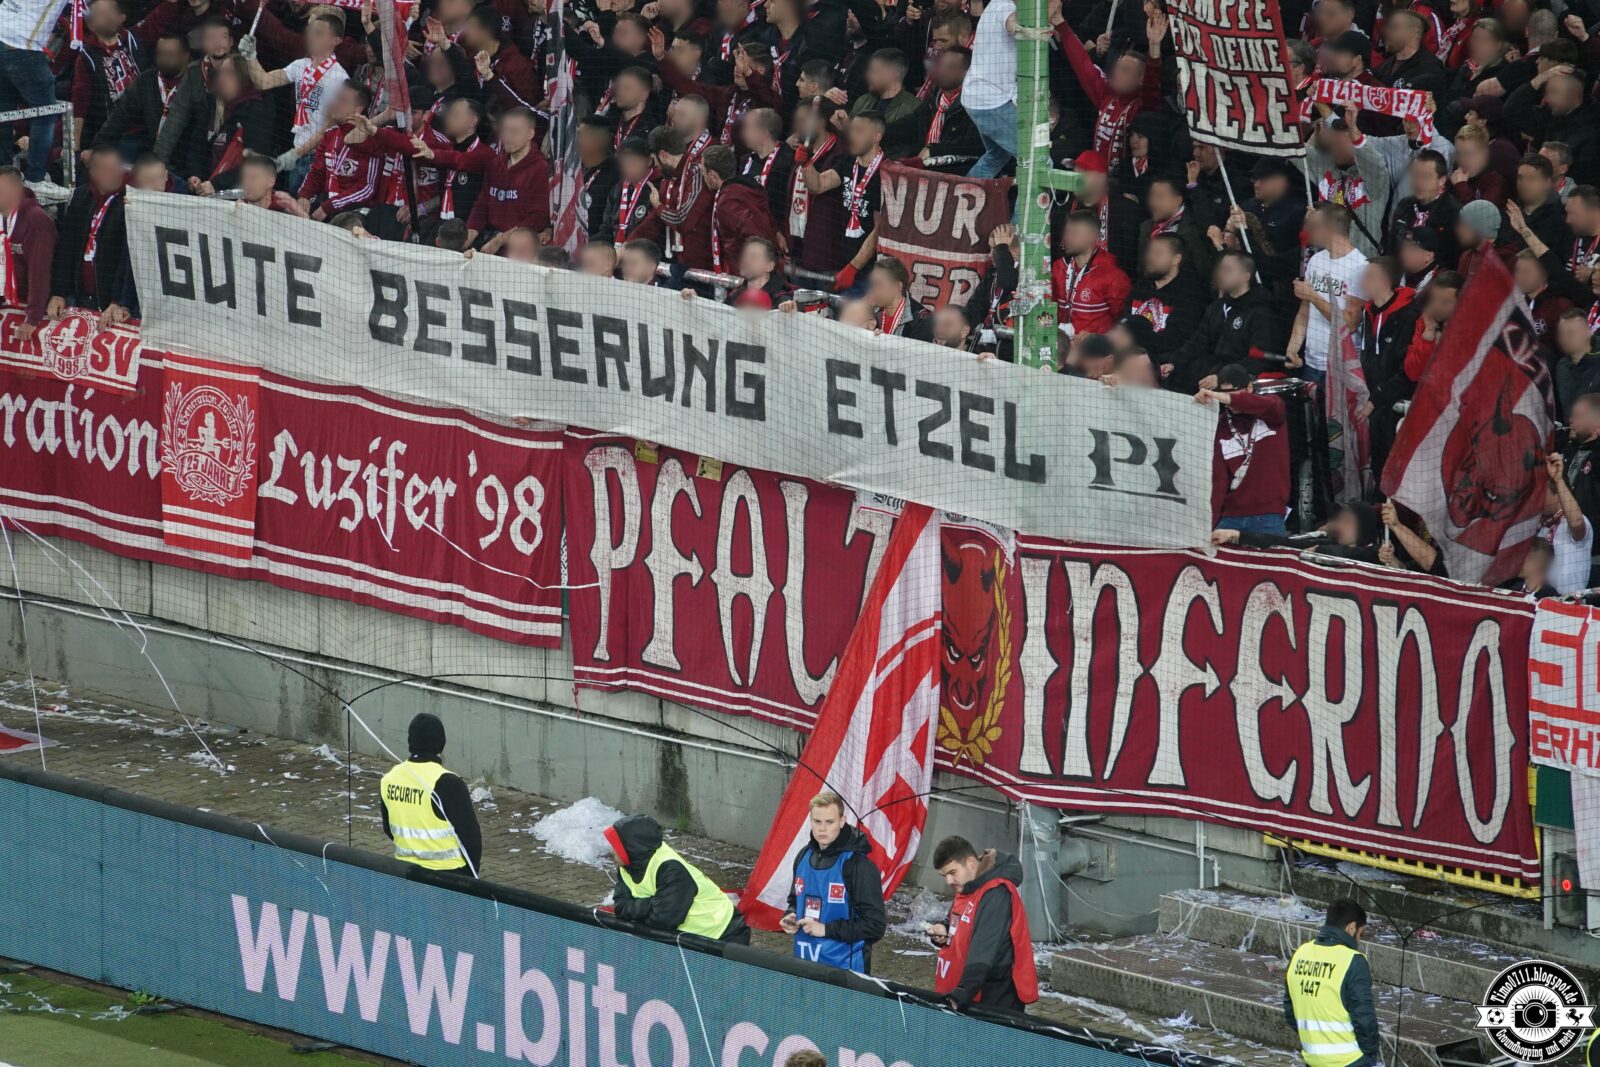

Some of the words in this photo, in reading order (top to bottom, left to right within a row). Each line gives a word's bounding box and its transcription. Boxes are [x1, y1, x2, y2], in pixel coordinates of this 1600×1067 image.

[1209, 33, 1286, 73] DEINE
[1176, 56, 1300, 144] ZIELE
[880, 170, 980, 246] NUR
[90, 331, 141, 377] SV
[155, 225, 322, 328] GUTE
[368, 269, 766, 422] BESSERUNG
[825, 358, 1047, 484] ETZEL
[201, 457, 232, 490] JAHRE
[258, 429, 457, 548] Luzifer
[1018, 557, 1516, 845] INFERNO
[1531, 719, 1600, 769] ERH
[386, 784, 424, 805] SECURITY
[797, 941, 822, 963] TV
[1294, 959, 1336, 979] SECURITY
[1300, 979, 1321, 997] 1447
